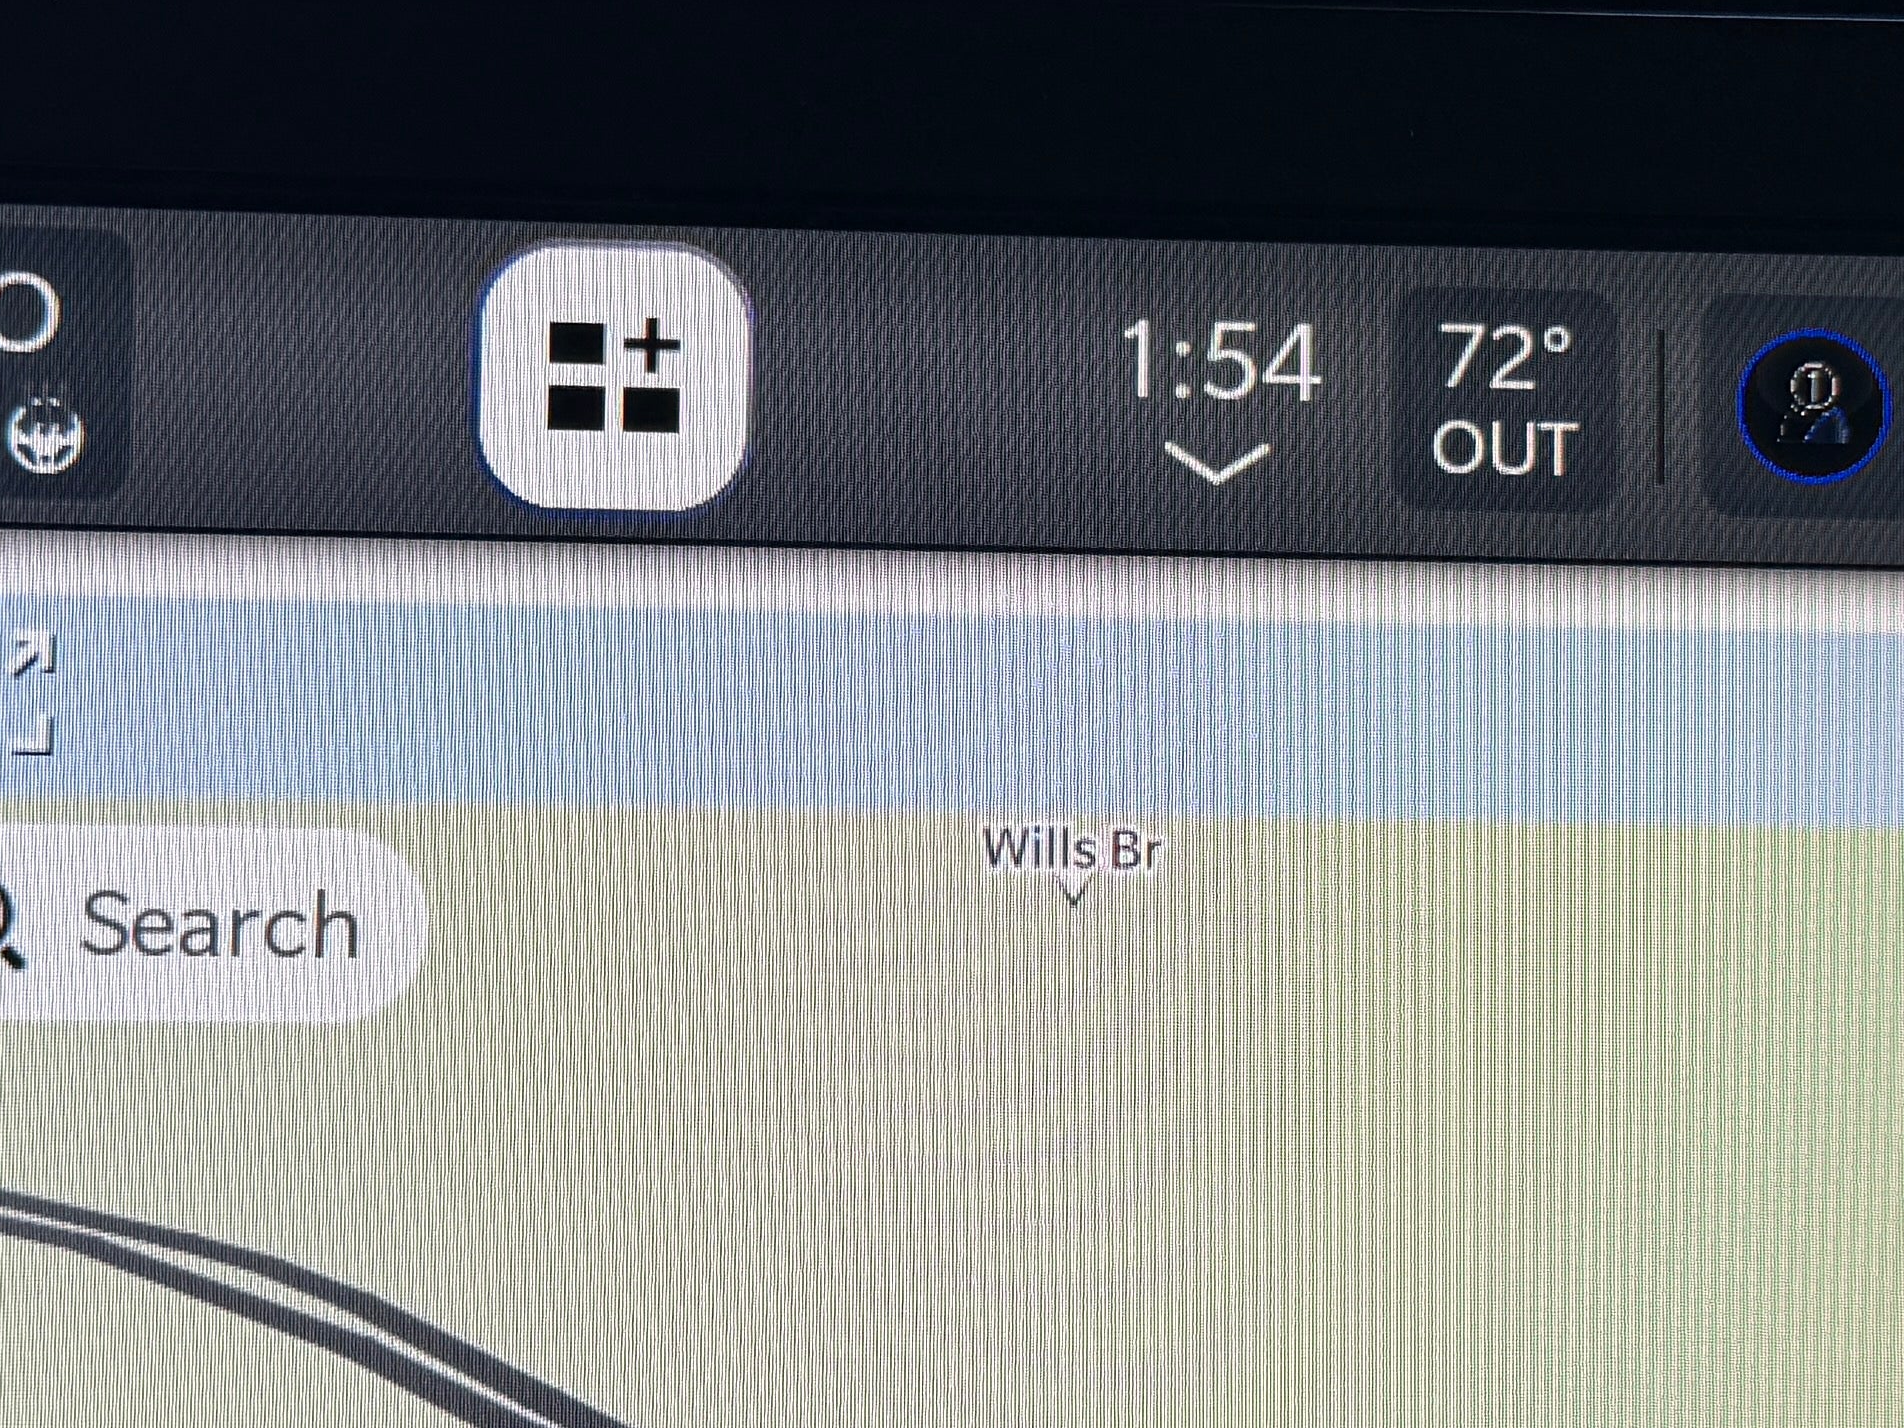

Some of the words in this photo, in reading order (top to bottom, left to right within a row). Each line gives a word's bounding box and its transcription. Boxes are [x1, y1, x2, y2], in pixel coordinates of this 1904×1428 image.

[1121, 318, 1322, 404] 1:54
[1438, 322, 1572, 392] 72°
[1432, 420, 1580, 480] OUT
[982, 825, 1098, 872] Wills
[1110, 827, 1164, 872] Br
[80, 884, 360, 960] Search
